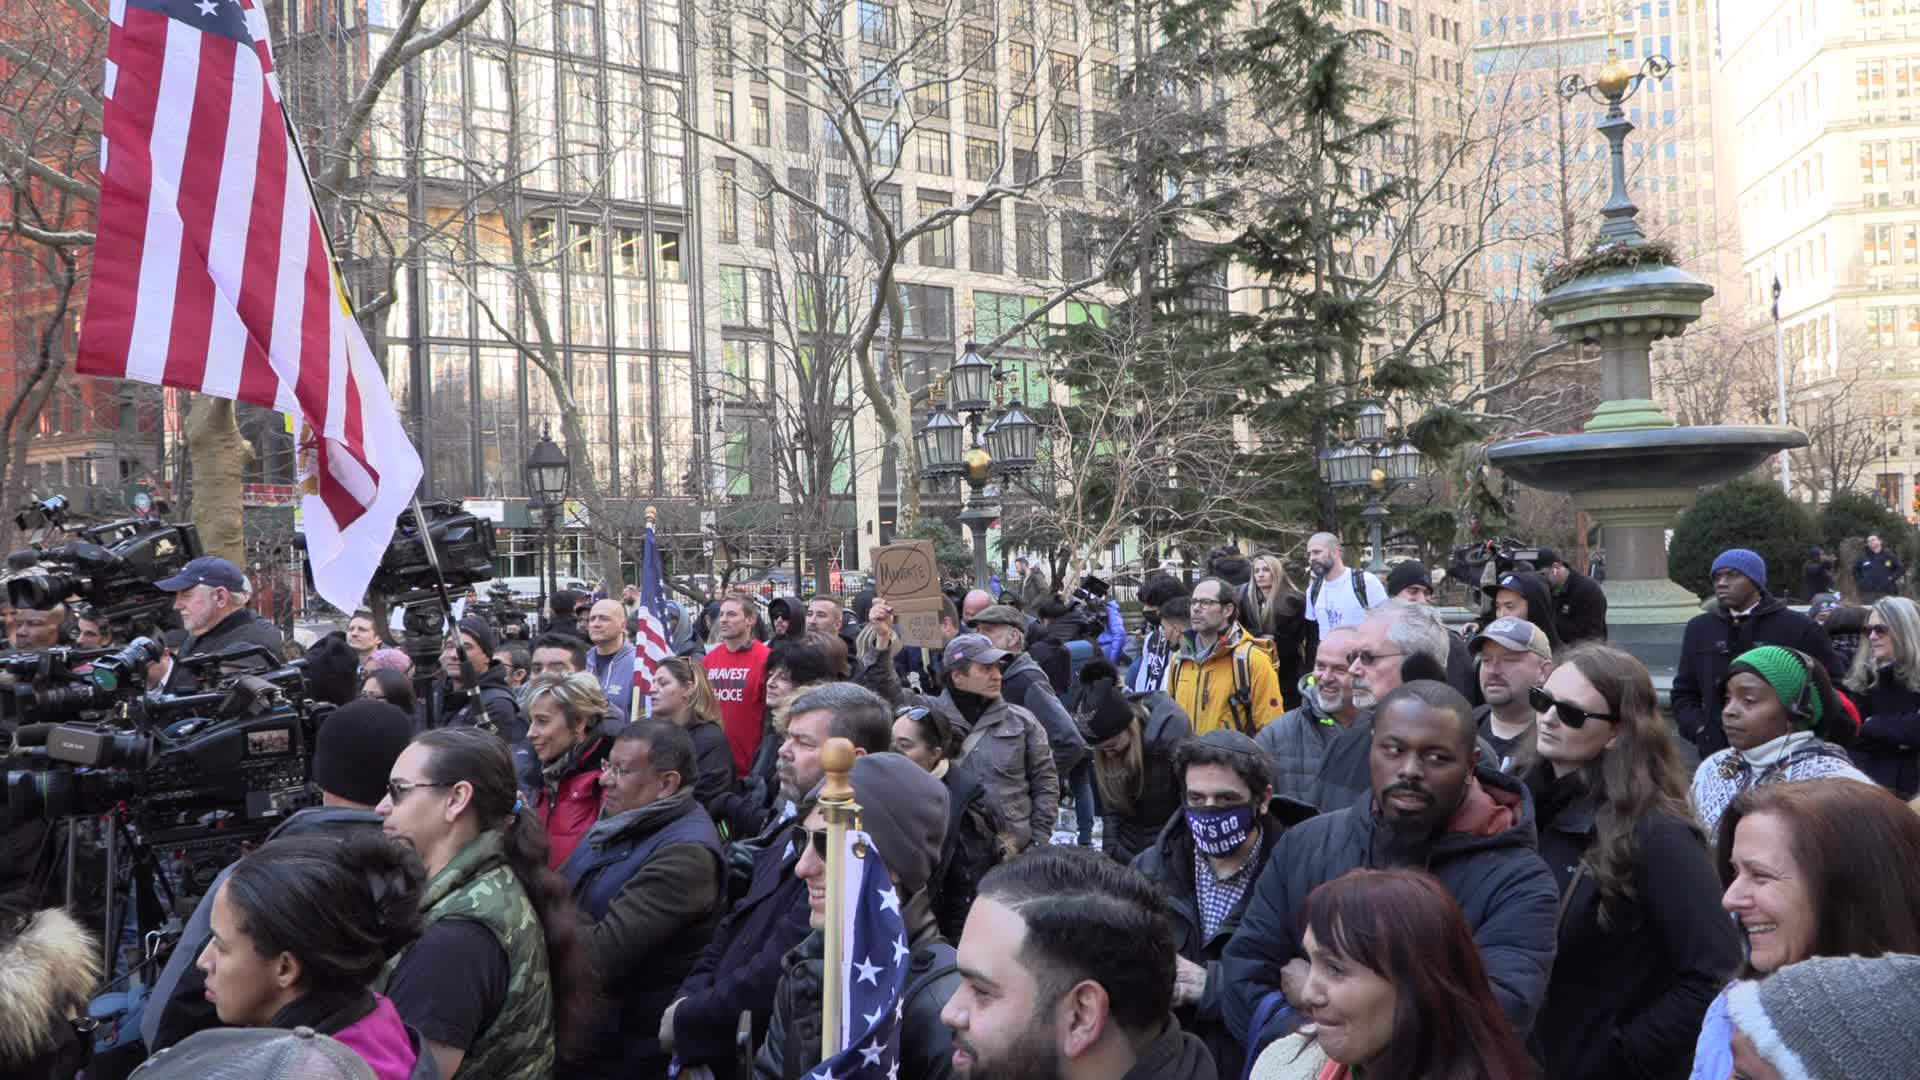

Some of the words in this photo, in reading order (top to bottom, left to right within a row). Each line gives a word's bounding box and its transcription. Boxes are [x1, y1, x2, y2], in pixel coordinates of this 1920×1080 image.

[707, 667, 750, 680] BRAVEST
[712, 688, 743, 702] HOICE
[1220, 815, 1240, 834] GO
